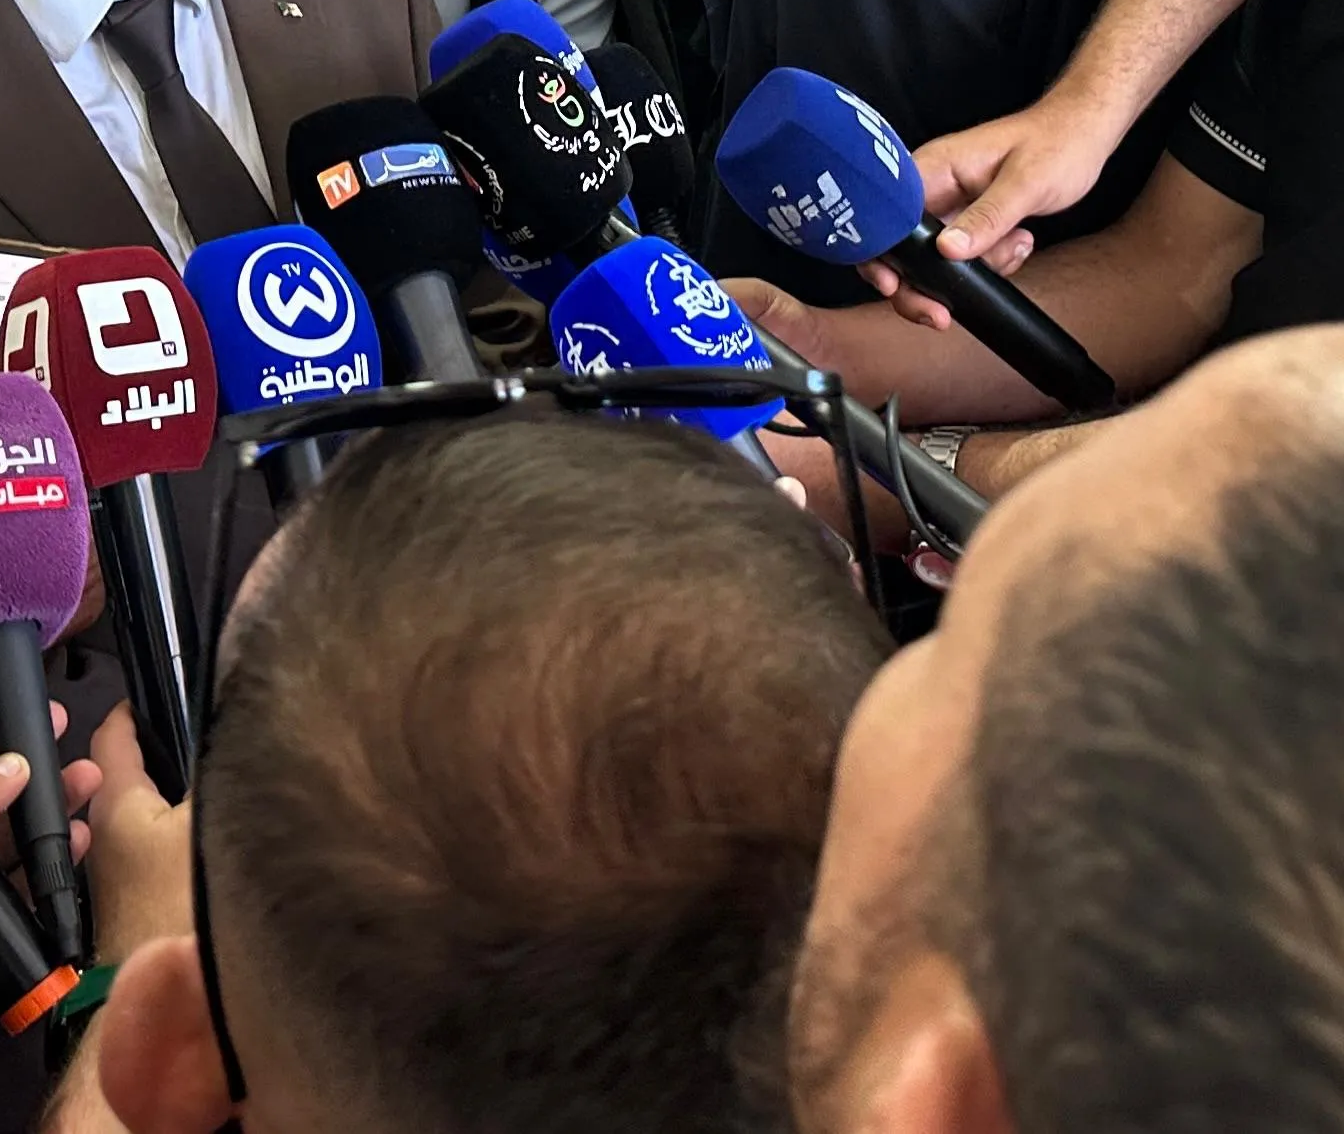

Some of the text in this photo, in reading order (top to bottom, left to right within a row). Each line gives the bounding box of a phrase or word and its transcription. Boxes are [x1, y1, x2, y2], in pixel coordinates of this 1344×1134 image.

[323, 168, 354, 201] TV
[281, 262, 301, 278] TV
[163, 341, 177, 356] TV
[259, 352, 370, 405] الوطنية
[101, 377, 196, 429] البلاد
